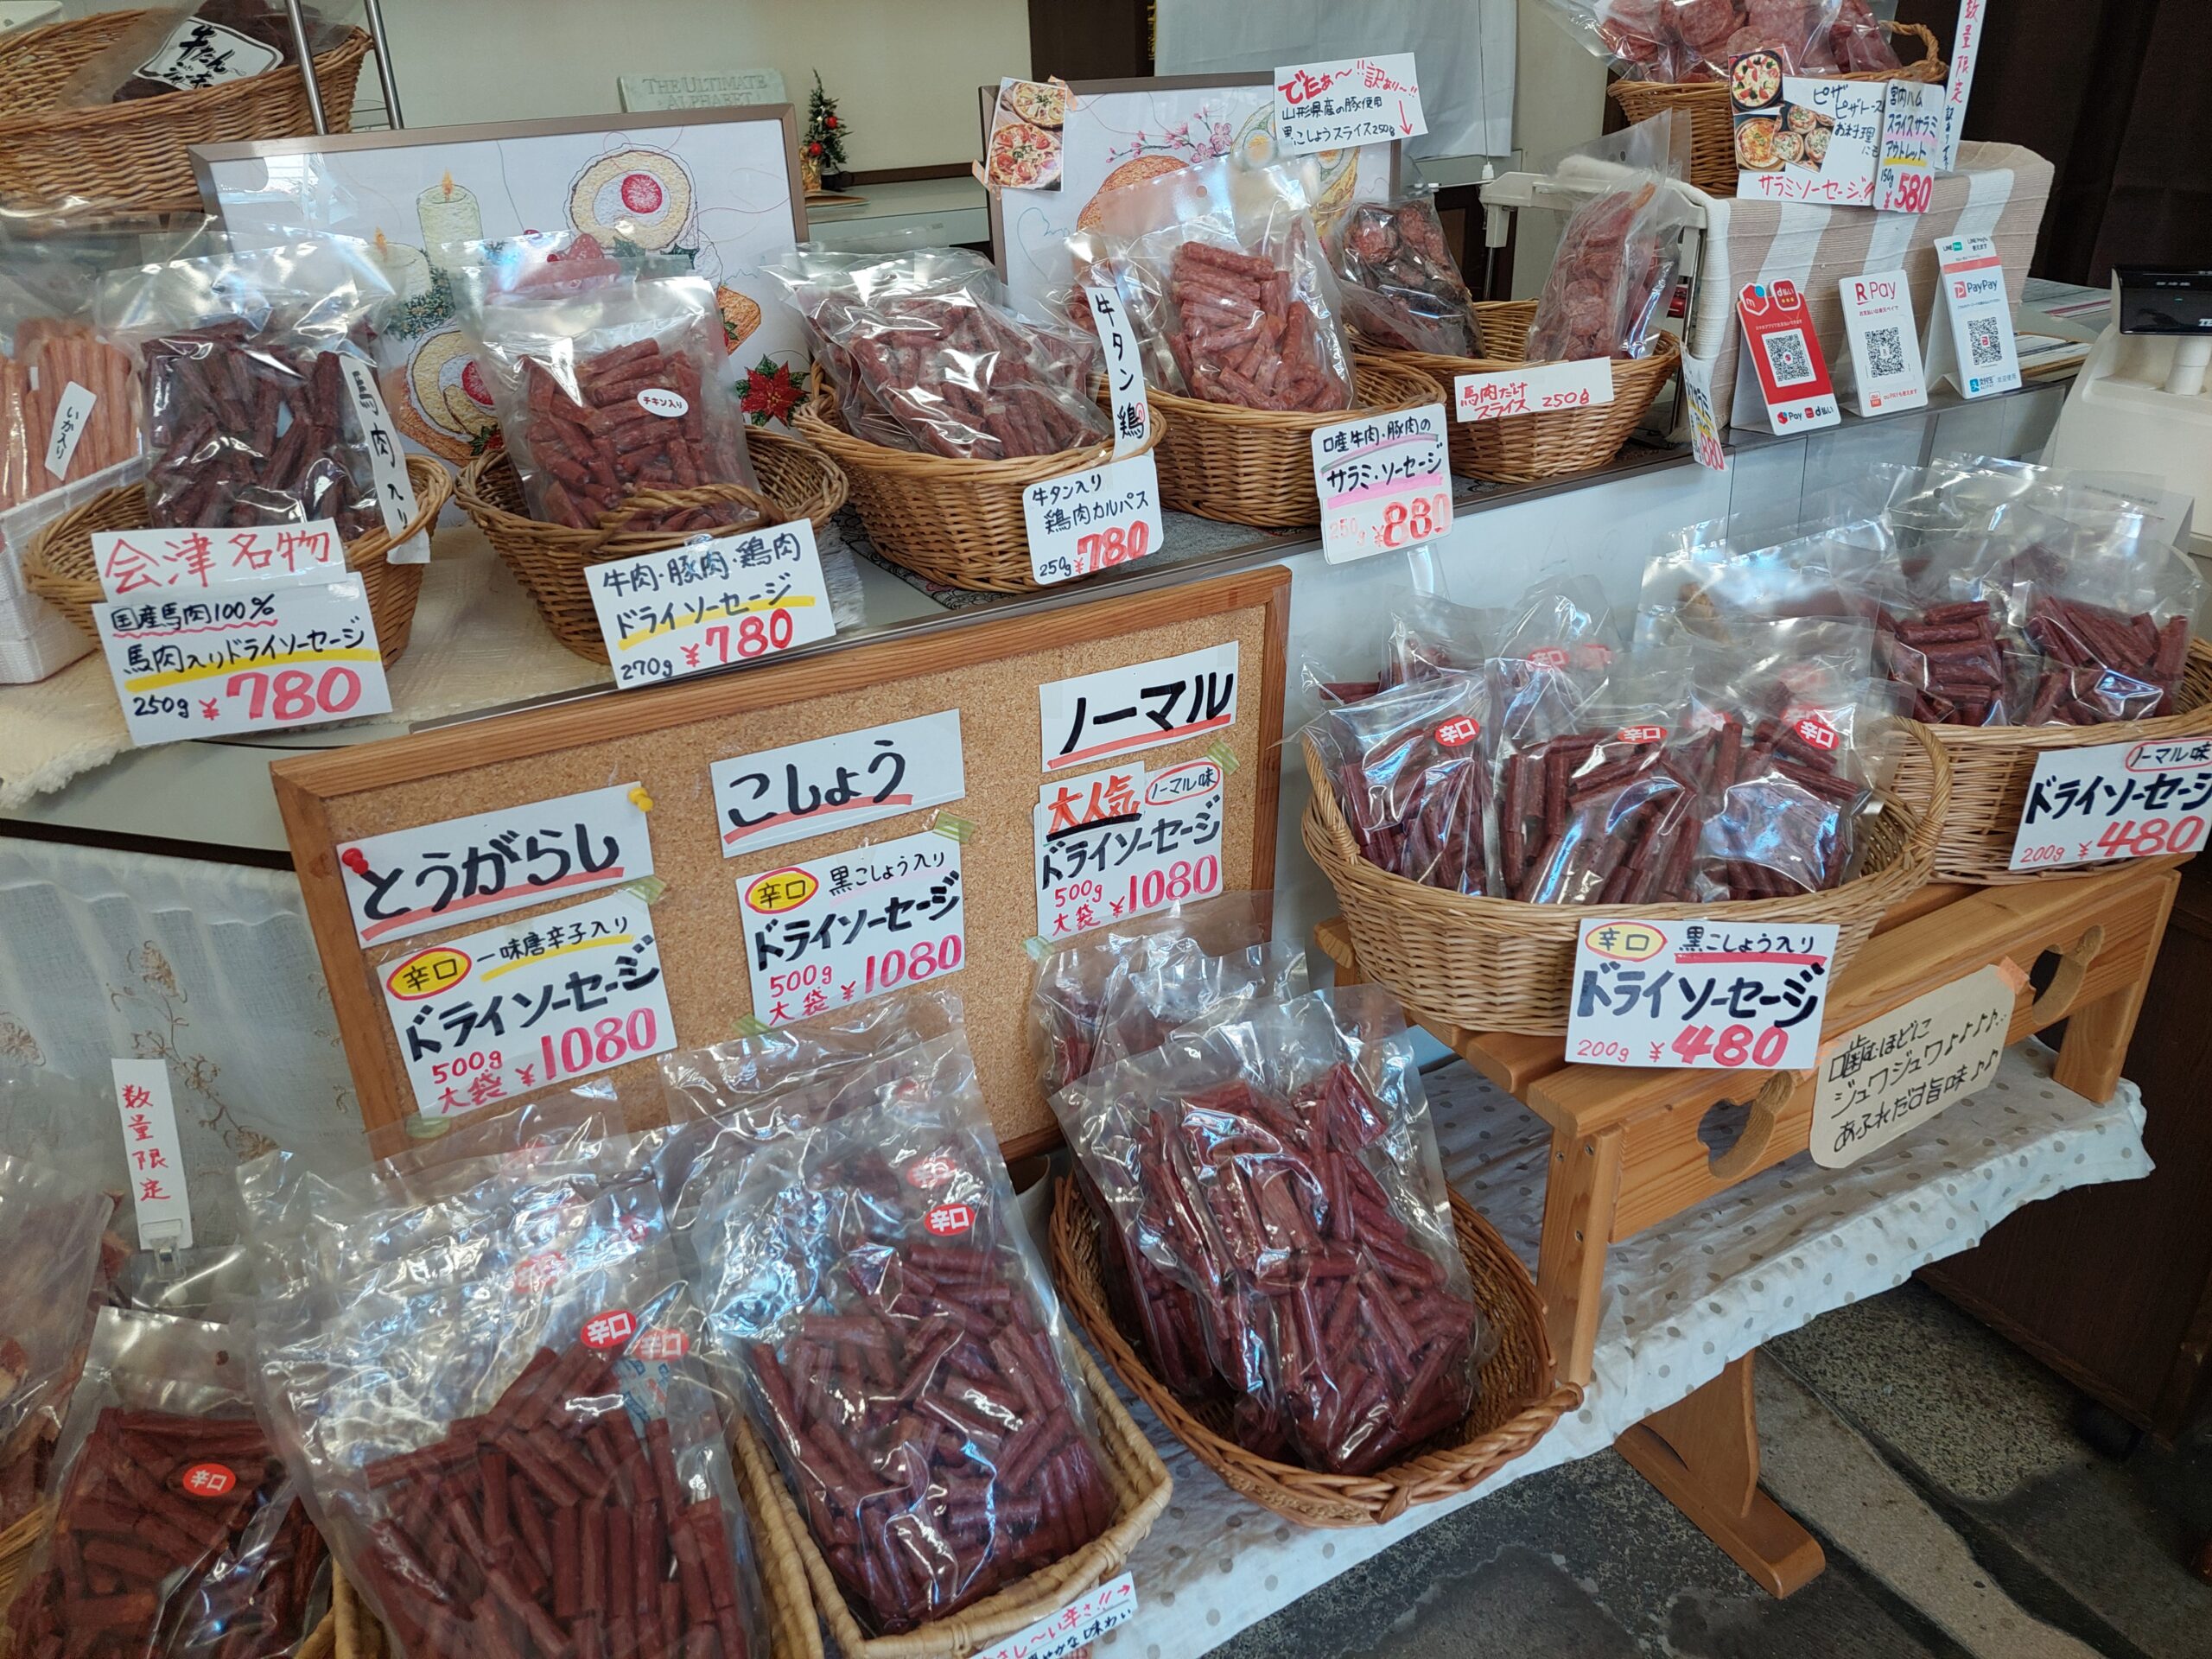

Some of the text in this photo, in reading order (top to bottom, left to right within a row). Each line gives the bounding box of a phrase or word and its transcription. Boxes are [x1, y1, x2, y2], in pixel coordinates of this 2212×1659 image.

[643, 74, 768, 95] THE ULTIMATE
[1814, 84, 1848, 105] ピザ
[1282, 96, 1382, 120] 山形県産の豚使用
[1887, 113, 1938, 138] スライスサラミ
[1834, 121, 1876, 143] お料理
[1885, 140, 1927, 161] アウトレット
[1881, 168, 1894, 188] 150g
[1884, 172, 1933, 213] ¥580
[1869, 281, 1897, 300] Pay
[1967, 279, 1998, 295] PayPay
[642, 395, 683, 410] チキン入り
[1460, 382, 1529, 407] 馬肉だけ
[1474, 398, 1531, 420] スライス
[54, 406, 79, 461] いか入り
[1788, 410, 1802, 422] Pay
[1033, 474, 1102, 506] 牛タン入り
[1044, 490, 1149, 535] 鶏肉カルパス
[105, 530, 330, 594] 会津名物
[603, 532, 802, 598] 牛肉・豚肉・鶏肉
[1039, 520, 1151, 577] 250g ¥780
[111, 594, 276, 631] 国産馬肉100%
[616, 572, 792, 639] ドライソーセージ
[124, 616, 365, 675] 馬肉入りドライソーセージ
[620, 607, 793, 680] 270g ¥780
[133, 667, 361, 721] 250g ¥780
[1059, 671, 1234, 755] ノーマル
[1439, 719, 1477, 743] 辛口
[1624, 727, 1661, 741] 辛口
[1800, 720, 1834, 748] 辛口
[2130, 741, 2212, 767] ノーマル味
[728, 740, 906, 827] こしょう
[1048, 766, 1214, 834] 大人気 ノーマル味
[1042, 794, 1221, 890] ドライソーセージ
[2020, 816, 2205, 863] 200g ¥480
[360, 823, 620, 920] とうがらし
[758, 851, 944, 909] 辛口 黒こしょう入り
[1052, 854, 1218, 937] 大袋 ¥1080
[1054, 879, 1103, 908] 500g
[755, 870, 960, 971] ドライソーセージ
[403, 916, 629, 992] 辛口 一味唐辛子入り
[1598, 925, 1816, 955] 辛口 黒こしょう入り
[404, 934, 660, 1062] ドライソーセージ
[769, 934, 963, 1027] 大袋 ¥1080
[770, 964, 833, 999] 500g
[1577, 961, 1826, 1028] ドライソーセージ
[437, 1007, 658, 1114] 大袋 ¥1080
[1576, 1024, 1789, 1066] 200g ¥480
[432, 1050, 503, 1084] 500g
[123, 1084, 171, 1203] 数量限定
[930, 1206, 969, 1232] 辛口
[587, 1313, 632, 1344] 辛口
[639, 1332, 682, 1356] 辛口
[189, 1470, 228, 1491] 辛口
